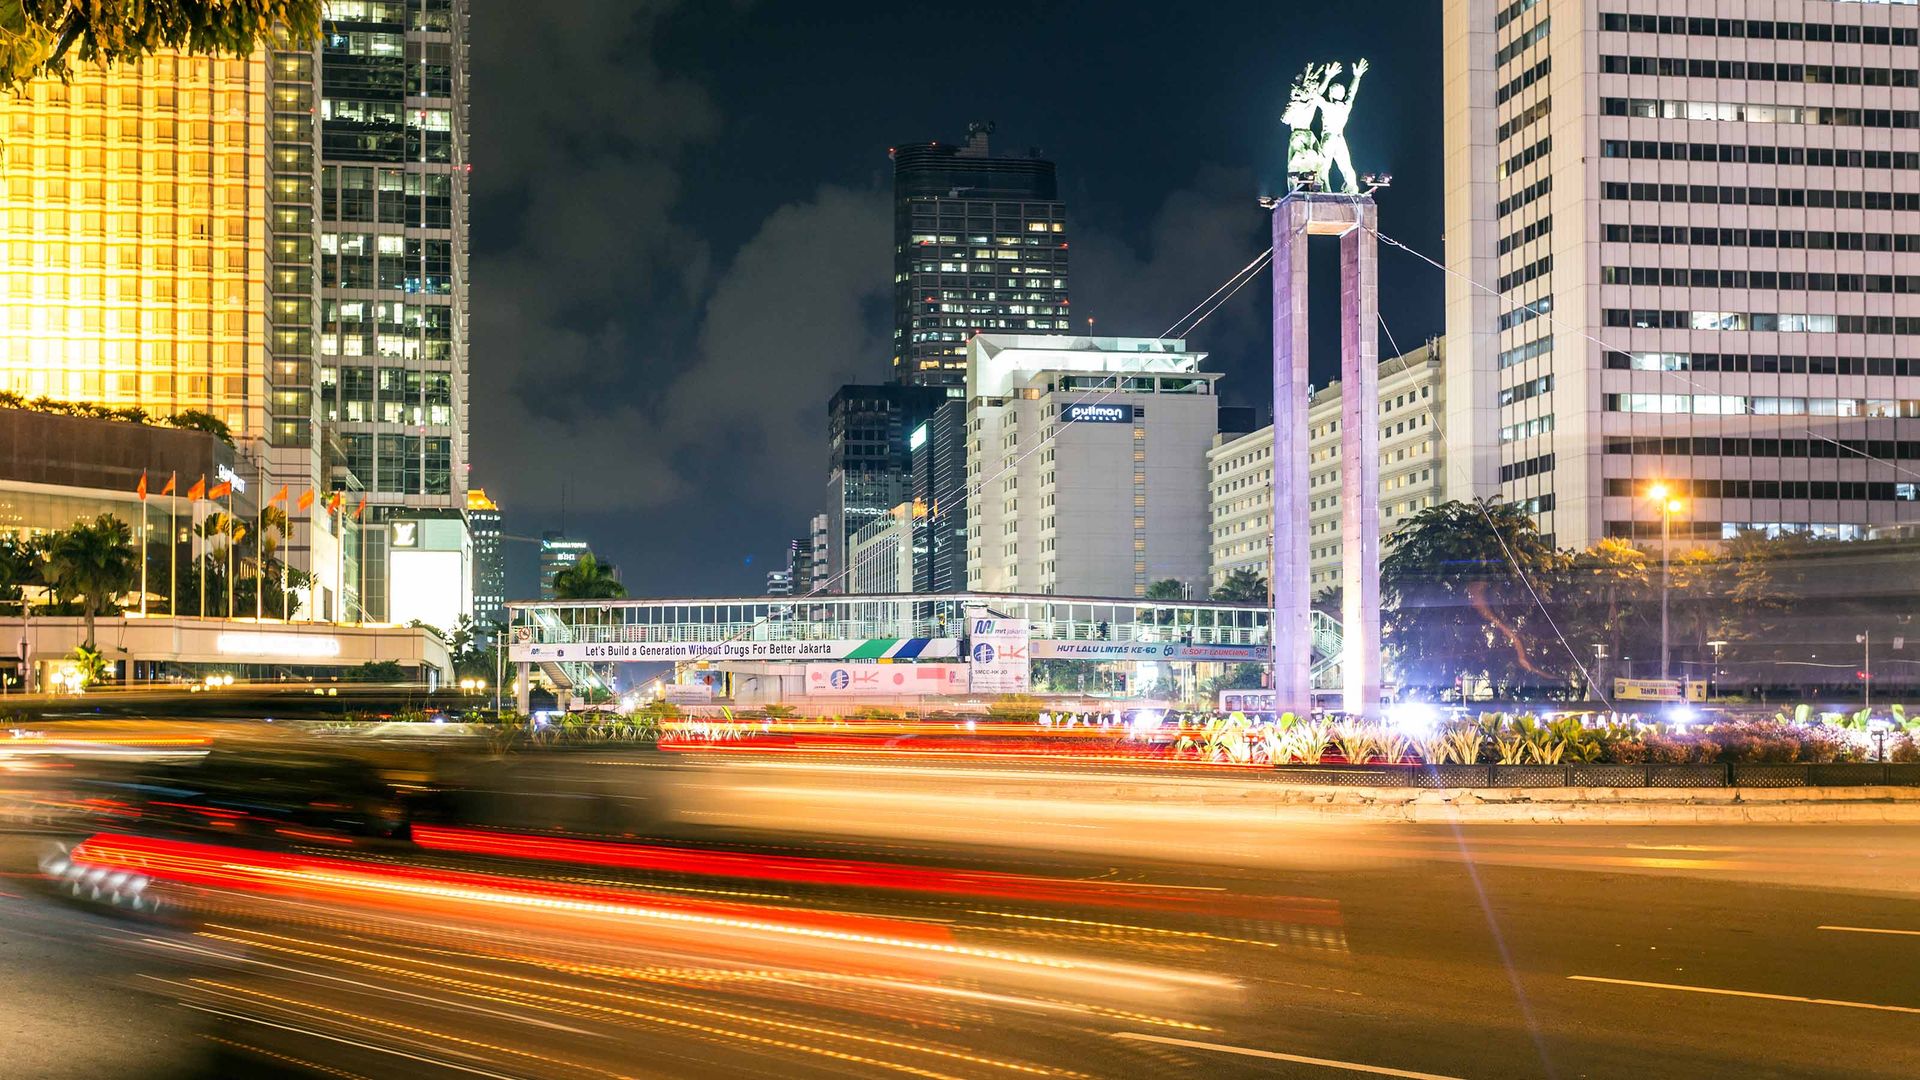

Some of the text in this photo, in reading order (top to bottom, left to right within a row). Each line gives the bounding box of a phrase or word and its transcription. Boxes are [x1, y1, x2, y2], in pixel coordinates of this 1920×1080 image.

[1072, 406, 1122, 419] pullman
[585, 643, 831, 657] Let's Build a Generation Without Drugs For Better Jakarta
[1076, 645, 1100, 653] LALU
[1189, 648, 1208, 656] SOFT
